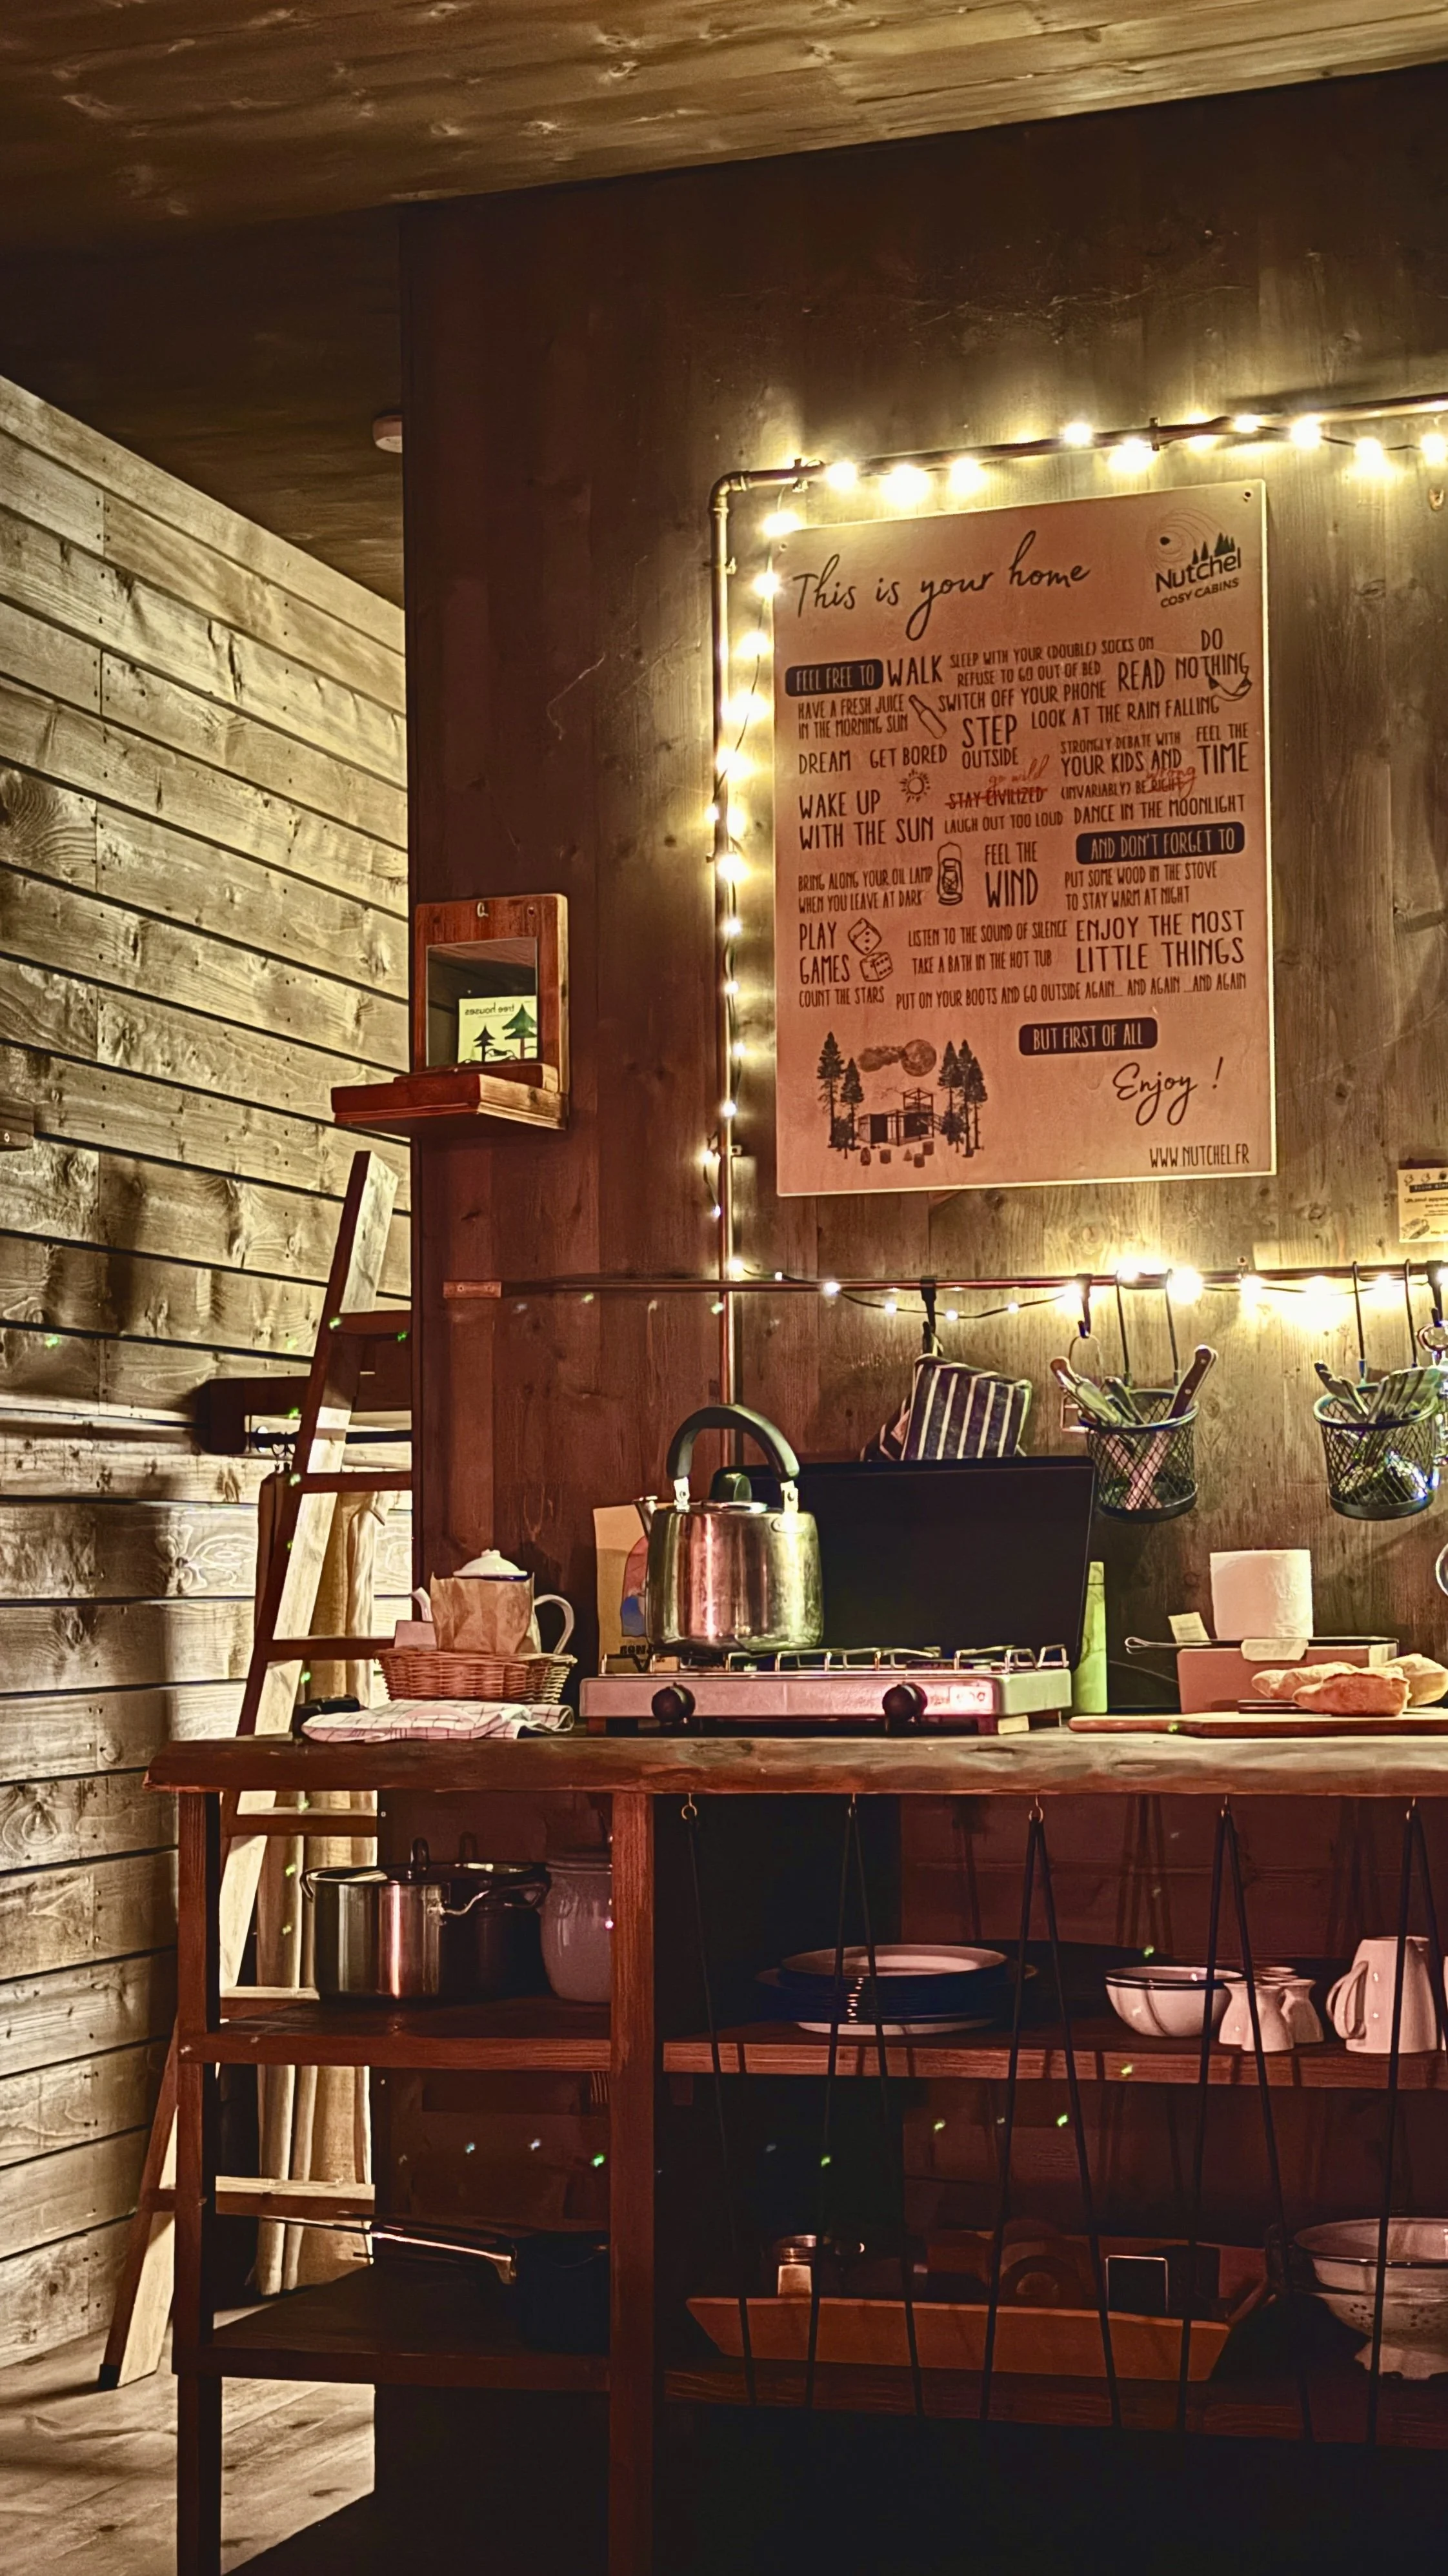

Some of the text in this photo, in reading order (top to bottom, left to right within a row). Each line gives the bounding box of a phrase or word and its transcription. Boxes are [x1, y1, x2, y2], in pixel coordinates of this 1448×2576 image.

[1156, 547, 1242, 593] Nutchel
[793, 530, 1091, 641] This is your home
[1161, 578, 1239, 608] COSY CABINS
[950, 637, 1154, 669] SLEEP WITH YOUR (DOUBLE) SOCKS ON
[1201, 628, 1223, 651] DO
[796, 664, 874, 692] FEEL FREE TO
[887, 655, 943, 687] WALK
[958, 661, 1100, 687] REFUSE TO GO OUT OF BED
[1118, 658, 1165, 691] READ
[1176, 653, 1249, 680] NOTHING
[798, 695, 904, 720] HAVE A FRESH JUICE
[939, 680, 1106, 713] SWITCH OFF YOUR PHONE
[1032, 695, 1219, 729] LOOK AT THE RAIN FALLING
[799, 714, 909, 740] IN THE MORNING SUN
[962, 715, 1017, 749] STEP
[1196, 723, 1249, 742] FEEL THE
[870, 744, 947, 768] GET BORED
[1061, 732, 1180, 755] STRONGLY DEBATE WITH
[799, 749, 851, 775] DREAM
[962, 747, 1019, 769] OUTSIDE
[1061, 748, 1182, 777] YOUR KIDS AND
[1197, 742, 1249, 775] TIME
[799, 789, 880, 819] WAKE UP
[949, 787, 1043, 809] STAY CIVILIZED
[1061, 782, 1131, 800] (INVARIABLY)
[1135, 780, 1147, 794] BE
[945, 811, 1063, 834] LAUGH OUT TOO LOUD
[1074, 795, 1245, 824] DANCE IN THE MOONLIGHT
[799, 816, 934, 849] WITH THE SUN
[1091, 828, 1234, 860] AND DON'T FORGET TO
[985, 841, 1038, 866] FEEL THE
[798, 866, 933, 892] BRING ALONG YOUR OIL LAMP
[985, 868, 1038, 908] WIND
[1065, 861, 1218, 888] PUT SOME WOOD IN THE STOVE
[799, 889, 923, 914] WHEN YOU LEAVE AT DARK
[1065, 886, 1190, 911] TO STAY WARM AT NIGHT
[799, 921, 837, 951] PLAY
[909, 920, 1067, 947] LISTEN TO THE SOUND OF SILENCE
[1076, 910, 1244, 942] ENJOY THE MOST
[912, 949, 1052, 975] TAKE A BATH IN THE HOT TUB
[1077, 937, 1244, 973] LITTLE THINGS
[800, 954, 850, 986] GAMES
[799, 986, 884, 1008] COUNT THE STARS
[896, 993, 914, 1010] PUT
[919, 992, 932, 1008] ON
[936, 991, 962, 1008] YOUR
[967, 988, 996, 1006] BOOTS
[1001, 986, 1020, 1004] AND
[1023, 986, 1036, 1003] GO
[1041, 982, 1080, 1001] OUTSIDE
[1127, 979, 1145, 996] AND
[1151, 976, 1180, 995] AGAIN
[1216, 973, 1247, 991] AGAIN
[1034, 1023, 1143, 1051] BUT FIRST OF ALL
[1112, 1062, 1198, 1126] Enjoy
[1150, 1143, 1249, 1168] WWW.NUTCHEL.FR
